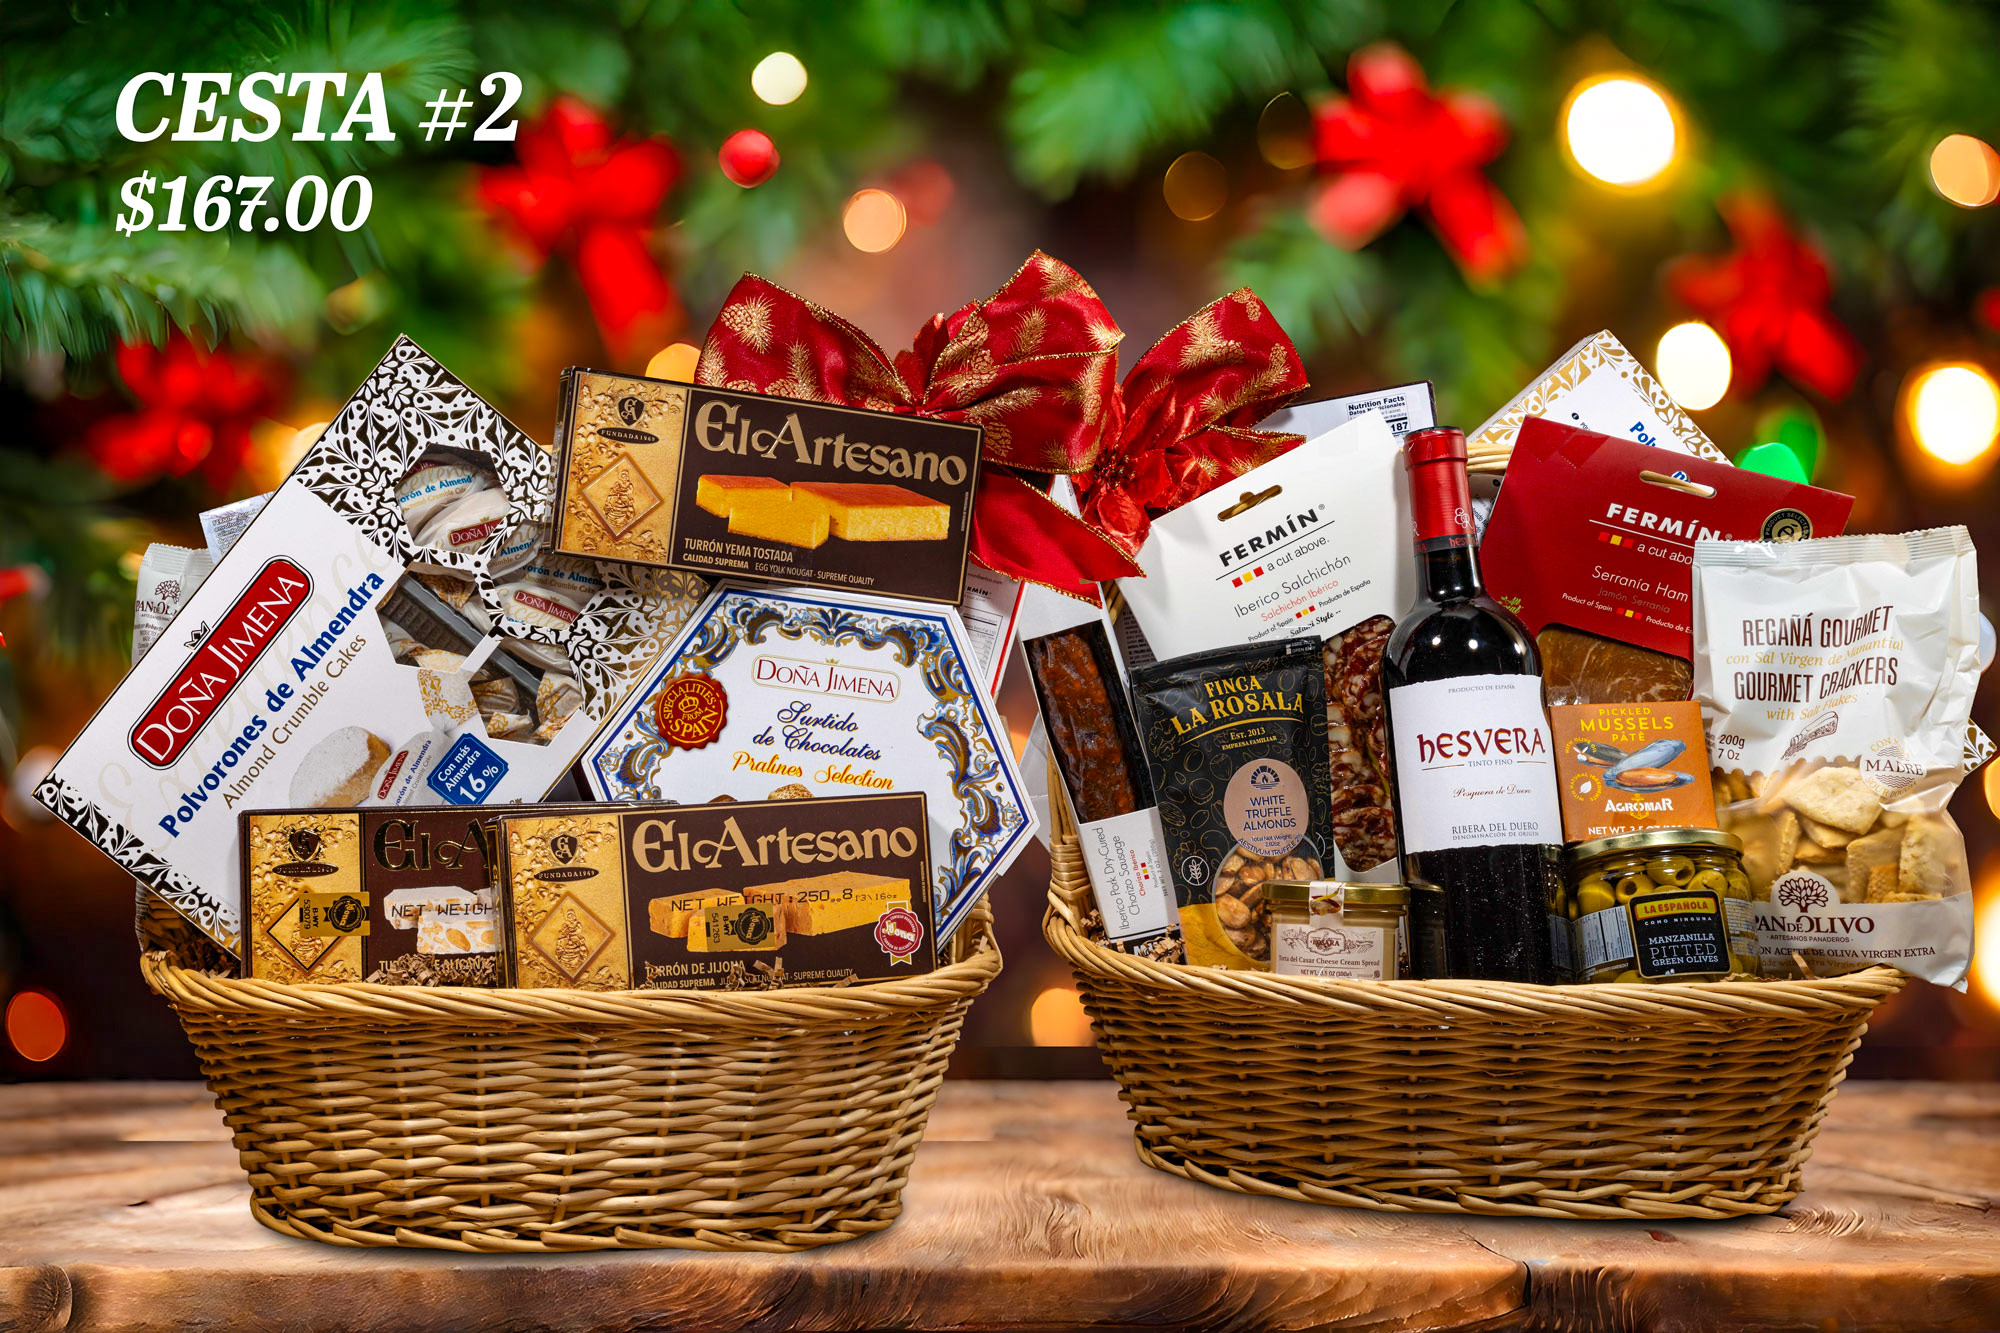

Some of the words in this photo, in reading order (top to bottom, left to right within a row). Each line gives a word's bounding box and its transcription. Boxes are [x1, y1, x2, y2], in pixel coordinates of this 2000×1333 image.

[1348, 400, 1382, 410] Nutrition
[1383, 396, 1405, 404] Facts
[1391, 422, 1408, 431] 187
[425, 484, 436, 494] de
[450, 529, 482, 545] DOÑA
[684, 537, 723, 554] TURRÓN
[725, 543, 751, 557] YEMA
[753, 547, 793, 562] TOSTADA
[1267, 563, 1275, 571] a
[1276, 552, 1293, 567] cut
[1294, 536, 1330, 557] above.
[1637, 543, 1645, 552] a
[1648, 544, 1668, 559] cut
[682, 553, 714, 565] CALIDAD
[714, 557, 749, 569] SUPREMA
[755, 562, 768, 572] EGG
[769, 564, 785, 574] YOLK
[786, 568, 813, 578] NOUGAT
[817, 570, 847, 583] SUPREME
[848, 575, 874, 585] QUALITY
[1234, 591, 1280, 617] Iberico
[1281, 555, 1351, 594] Salchichón
[1592, 566, 1650, 593] Serranía
[1655, 581, 1689, 602] Ham
[515, 592, 546, 609] DOÑA
[1260, 594, 1307, 621] Salchichón
[1308, 580, 1339, 599] Ibérico
[1318, 594, 1342, 607] Producto
[1350, 579, 1371, 595] España
[1597, 586, 1628, 602] Jamón
[1562, 593, 1586, 605] Product
[1594, 600, 1613, 612] Spain
[1315, 610, 1334, 626] Style
[1646, 615, 1674, 629] Producto
[1247, 628, 1270, 642] Product
[1277, 617, 1294, 629] Spain
[1742, 612, 1813, 648] REGAÑÁ
[1820, 605, 1894, 648] GOURMET
[1725, 654, 1749, 666] con
[1754, 651, 1774, 665] Sal
[1779, 652, 1823, 668] Virgen
[1828, 653, 1842, 666] de
[1844, 638, 1904, 663] Manantial
[136, 672, 227, 761] DOÑA
[207, 576, 304, 678] JIMENA
[757, 659, 820, 688] DOÑA
[824, 666, 895, 698] JIMENA
[1204, 675, 1262, 698] FINCA
[1734, 671, 1814, 703] GOURMET
[1819, 656, 1899, 700] CRACKERS
[1448, 685, 1483, 693] PRODUCTO
[158, 714, 267, 838] Polvorones
[265, 683, 294, 712] de
[291, 572, 385, 681] Almendra
[663, 683, 716, 720] SPECIALITIES
[1766, 707, 1794, 721] with
[1799, 704, 1821, 721] Salt
[1822, 693, 1858, 712] Flakes
[681, 707, 704, 721] FROM
[777, 700, 859, 733] Surtido
[1170, 706, 1208, 736] LA
[1209, 691, 1304, 720] ROSALA
[1599, 707, 1651, 716] PICKLED
[222, 744, 276, 810] Almond
[272, 679, 329, 744] Crumble
[326, 634, 366, 679] Cakes
[670, 707, 719, 738] SPAIN
[1580, 716, 1674, 732] MUSSELS
[1248, 726, 1266, 737] 2013
[753, 726, 775, 746] de
[782, 725, 882, 761] Chocolates
[1221, 740, 1250, 751] EMPRESA
[1250, 735, 1277, 746] FAMILIAR
[1719, 734, 1745, 749] 200g
[406, 774, 413, 785] de
[411, 739, 432, 774] Almendra
[1727, 749, 1740, 760] Oz
[437, 761, 457, 782] Con
[454, 744, 471, 762] más
[444, 750, 481, 792] Almendra
[732, 751, 803, 777] Pralines
[814, 764, 894, 790] Selection
[1468, 759, 1492, 768] TINTO
[1865, 759, 1924, 775] MADRE
[378, 772, 395, 799] DOÑA
[389, 751, 408, 777] JIMENA
[1453, 787, 1494, 799] Pesquera
[1496, 787, 1505, 795] de
[1506, 784, 1531, 795] Duero
[1250, 795, 1285, 806] WHITE
[1245, 806, 1291, 818] TRUFFLE
[1243, 818, 1296, 831] ALMONDS
[1451, 824, 1486, 835] RIBERA
[1489, 823, 1507, 832] DEL
[1510, 822, 1539, 831] DUERO
[1588, 826, 1607, 835] NET
[693, 816, 918, 869] Artesano
[1452, 831, 1506, 841] DENOMINACIÓN
[1092, 827, 1115, 875] Dry-Cured
[1113, 835, 1130, 877] Sausage
[1107, 876, 1120, 896] Pork
[1136, 872, 1146, 896] Chorizo
[672, 898, 705, 911] NET
[1125, 879, 1140, 916] Chorizo
[392, 903, 426, 917] NET
[1120, 898, 1130, 931] Iberico
[1644, 904, 1655, 914] LA
[1658, 901, 1708, 912] ESPAÑOLA
[711, 912, 720, 944] 541263
[1645, 918, 1669, 926] COMO
[1648, 932, 1715, 945] MANZANILLA
[1649, 943, 1717, 959] PITTED
[1827, 949, 1858, 958] OLIVA
[1861, 950, 1901, 959] VIRGEN
[1903, 946, 1936, 957] EXTRA
[1316, 957, 1338, 965] Cheese
[1340, 958, 1360, 966] Cream
[1362, 959, 1380, 967] Spread
[1652, 956, 1685, 966] GREEN
[1686, 953, 1719, 963] OLIVES
[691, 963, 705, 975] DE
[793, 970, 825, 980] SUPREME
[826, 968, 854, 978] QUALITY
[679, 978, 715, 988] SUPREMA
